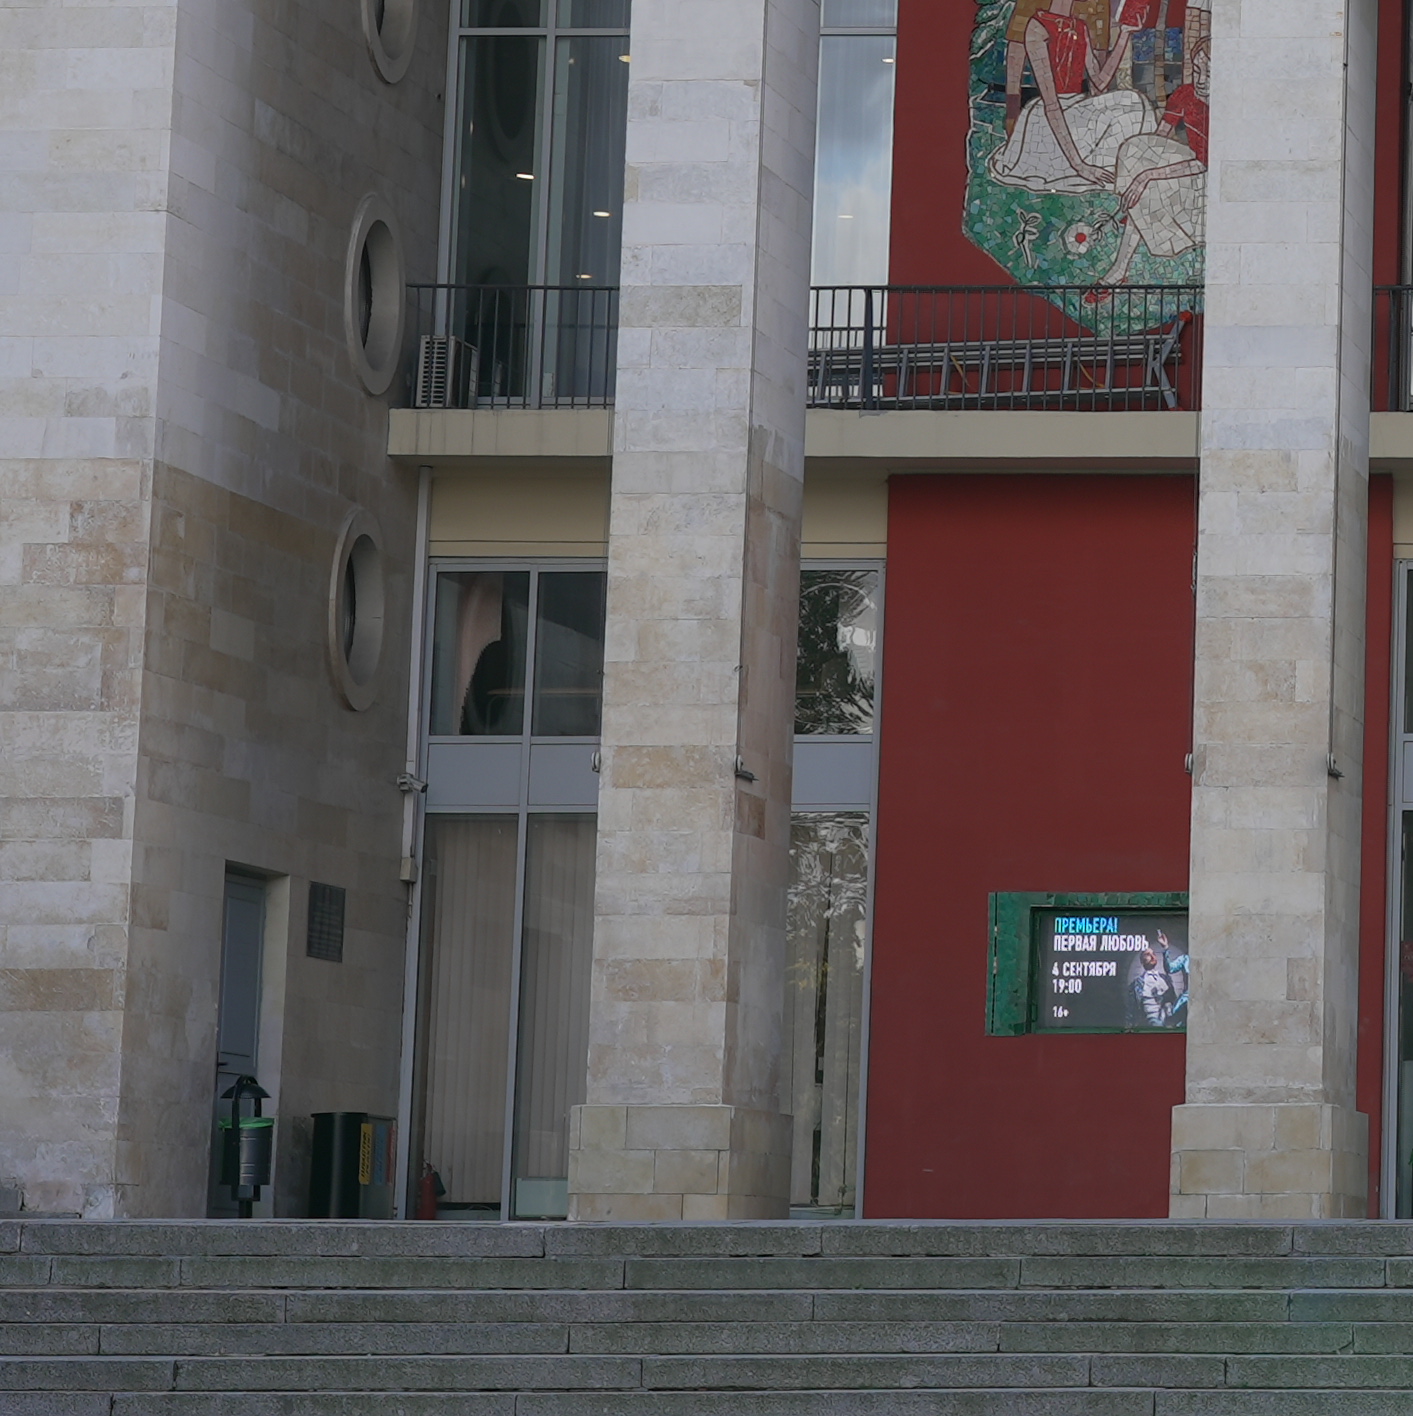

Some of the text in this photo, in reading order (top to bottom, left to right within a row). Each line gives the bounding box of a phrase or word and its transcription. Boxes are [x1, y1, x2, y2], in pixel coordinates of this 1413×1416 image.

[1055, 917, 1118, 933] ПРЕМЬЕРА!
[1053, 934, 1149, 951] ПЕРВАЯ ЛЮБОВЬ
[1062, 961, 1116, 976] СЕНТЯБРЯ
[1052, 978, 1082, 993] 19:00
[1052, 1005, 1069, 1017] 16+
